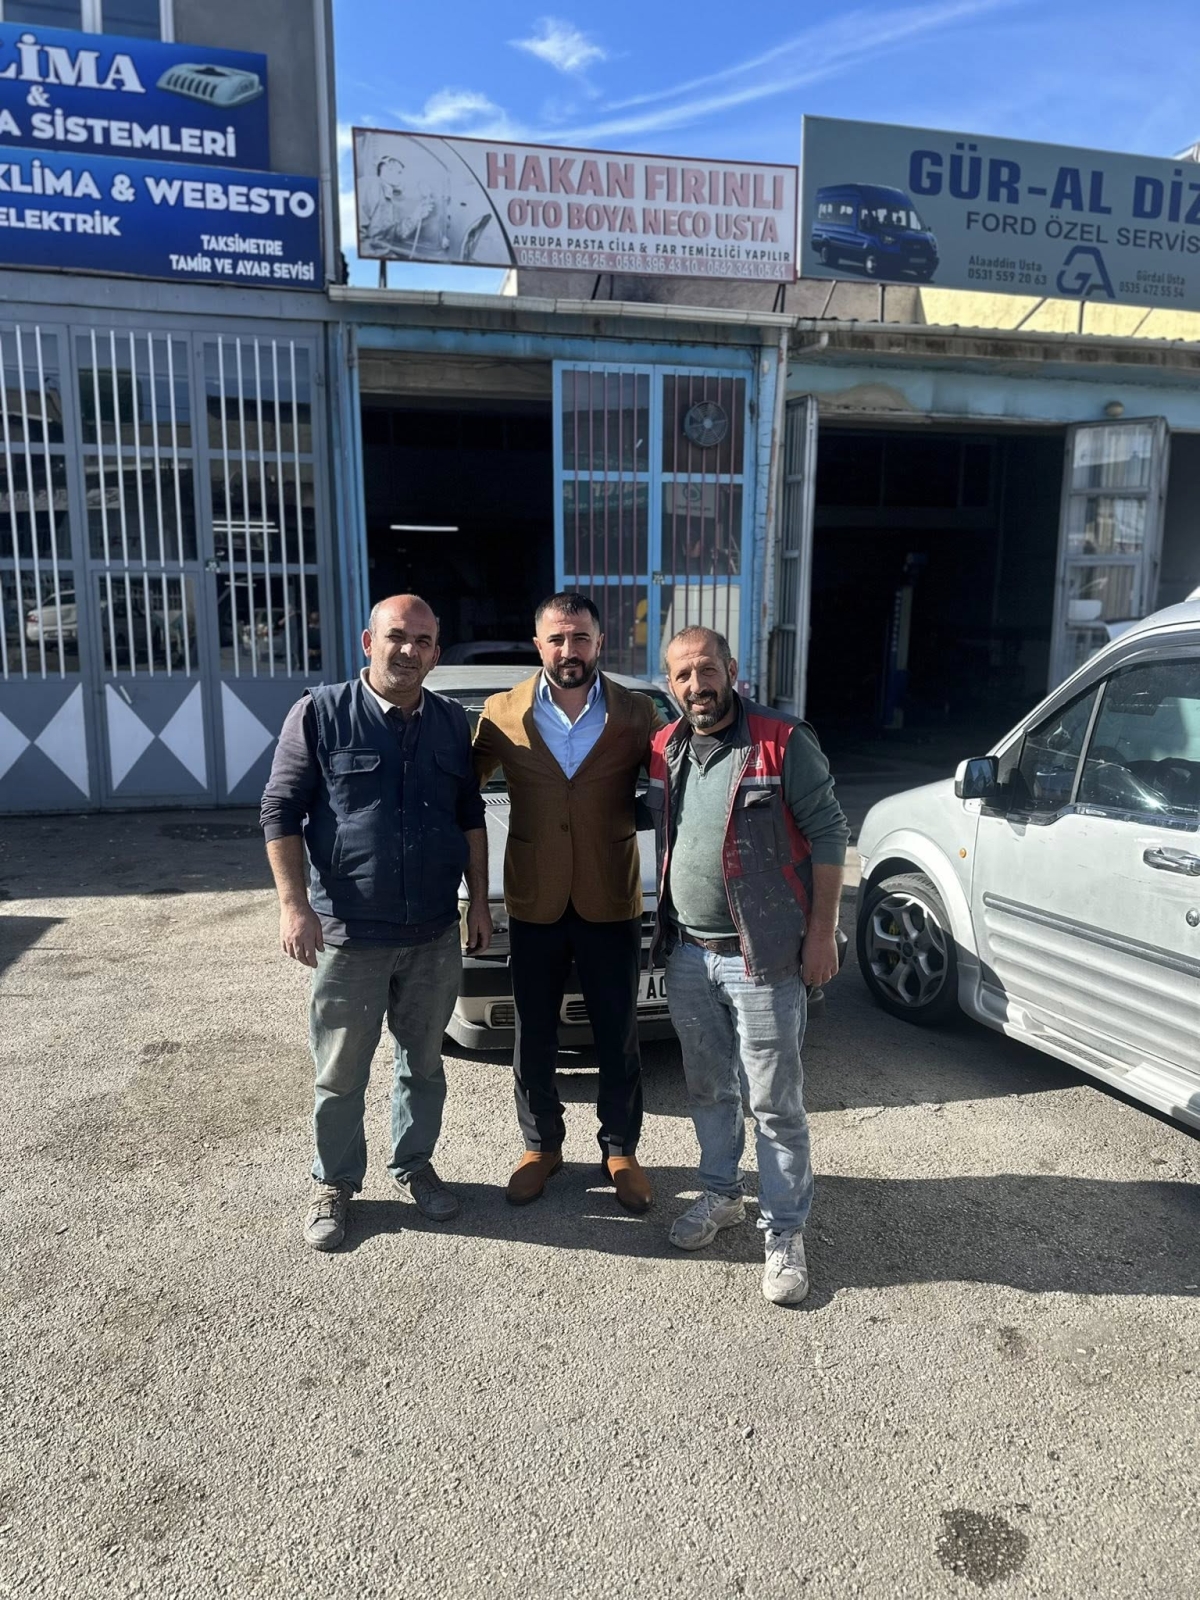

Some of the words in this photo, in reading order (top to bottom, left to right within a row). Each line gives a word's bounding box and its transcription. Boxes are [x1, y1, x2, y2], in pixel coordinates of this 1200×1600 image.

[26, 84, 51, 108] &
[31, 107, 237, 158] SİSTEMLERİ
[486, 152, 635, 199] HAKAN
[644, 164, 785, 211] FIRINLI
[908, 142, 1113, 215] GÜR-AL
[110, 174, 136, 203] &
[145, 176, 316, 219] WEBESTO
[507, 197, 563, 230] OTO
[567, 201, 638, 234] BOYA
[642, 206, 712, 240] NECO
[715, 212, 780, 244] USTA
[966, 210, 1037, 236] FORD
[1045, 214, 1109, 245] ÖZEL
[200, 233, 284, 257] TAKSİMETRE
[513, 234, 563, 248] AVRUPA
[567, 237, 605, 251] PASTA
[608, 237, 636, 252] CİLA
[639, 243, 648, 254] &
[655, 243, 677, 255] FAR
[681, 242, 741, 259] TEMİZLİĞİ
[745, 249, 791, 262] YAPILIR
[168, 252, 212, 274] TAMİR
[214, 258, 234, 275] VE
[236, 259, 271, 278] AYAR
[272, 262, 315, 282] SEVİSİ
[967, 267, 993, 281] 0531
[968, 254, 1016, 269] Alaaddin
[1018, 258, 1043, 273] Usta
